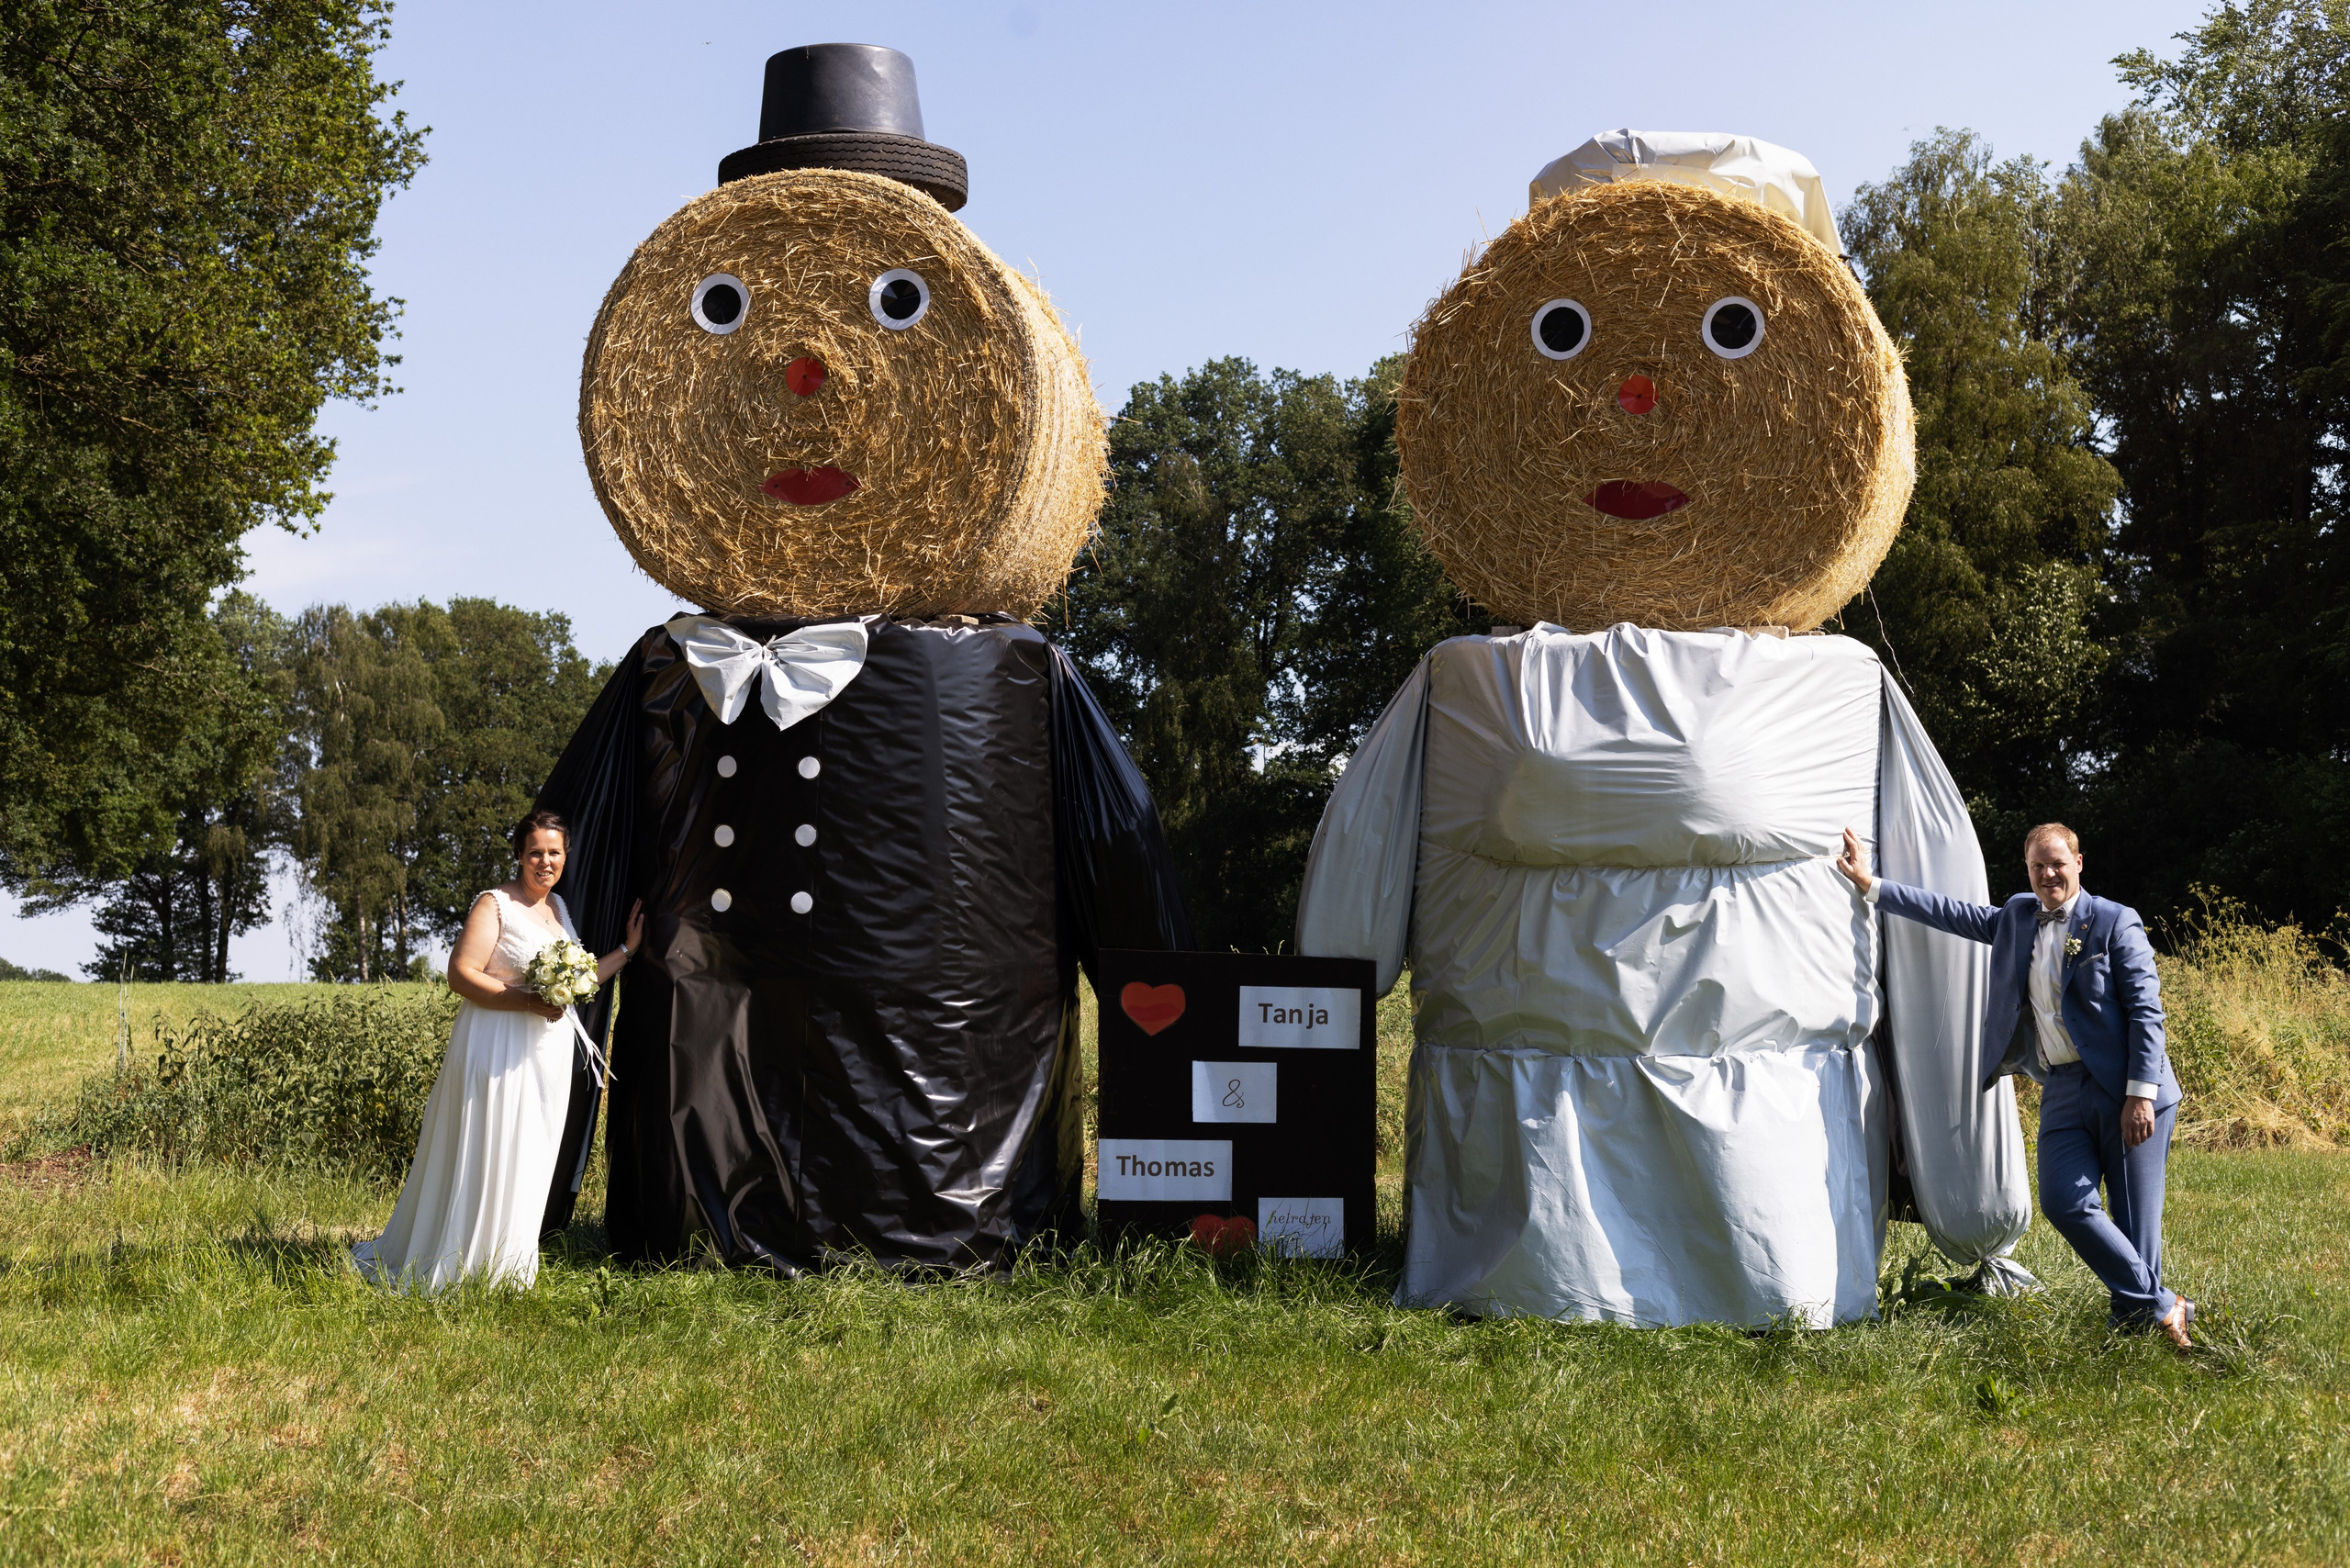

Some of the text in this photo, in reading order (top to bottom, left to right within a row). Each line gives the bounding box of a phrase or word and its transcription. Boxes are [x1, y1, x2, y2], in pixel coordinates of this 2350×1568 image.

[1259, 1002, 1328, 1030] Tanja
[1222, 1079, 1245, 1109] &
[1116, 1155, 1214, 1178] Thomas
